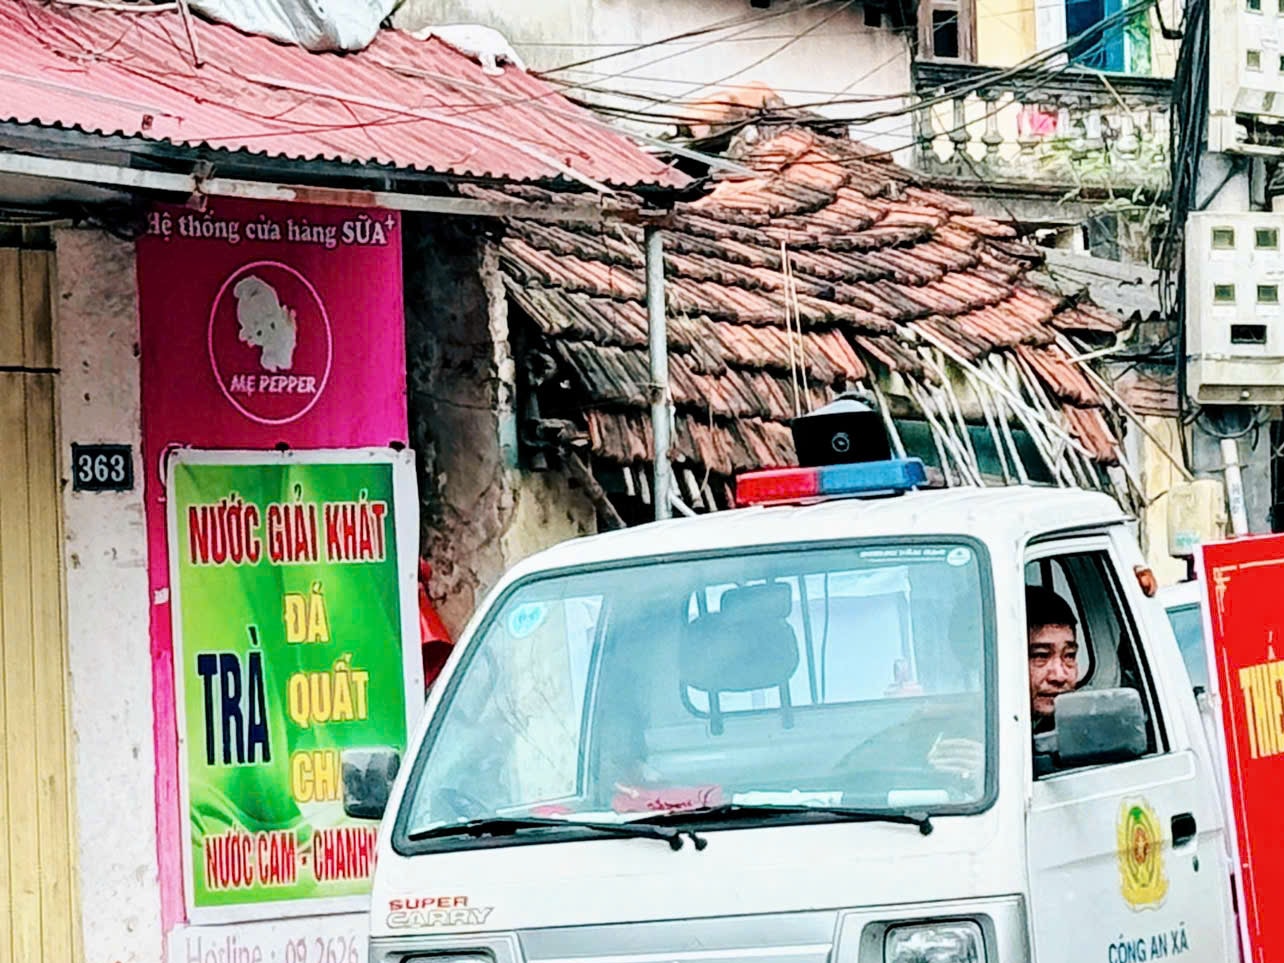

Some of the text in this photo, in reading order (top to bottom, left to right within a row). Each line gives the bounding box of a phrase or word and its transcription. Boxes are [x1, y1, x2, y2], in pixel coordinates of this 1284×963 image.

[147, 212, 172, 241] Hệ
[178, 209, 240, 245] thống
[245, 214, 281, 241] cửa
[286, 218, 337, 248] hàng
[258, 375, 316, 394] PEPPER
[78, 455, 126, 482] 363
[188, 483, 387, 565] NƯỚC GIẢI KHÁT
[283, 580, 331, 644] ĐÁ
[197, 625, 271, 766] TRÀ
[288, 653, 370, 729] QUẤT
[290, 750, 342, 802] CH
[205, 825, 254, 889] NƯỚC
[257, 831, 296, 886] CAM
[386, 906, 495, 929] CARRY
[388, 895, 469, 911] SUPER
[1150, 933, 1168, 959] AN
[1170, 921, 1189, 956] XÃ
